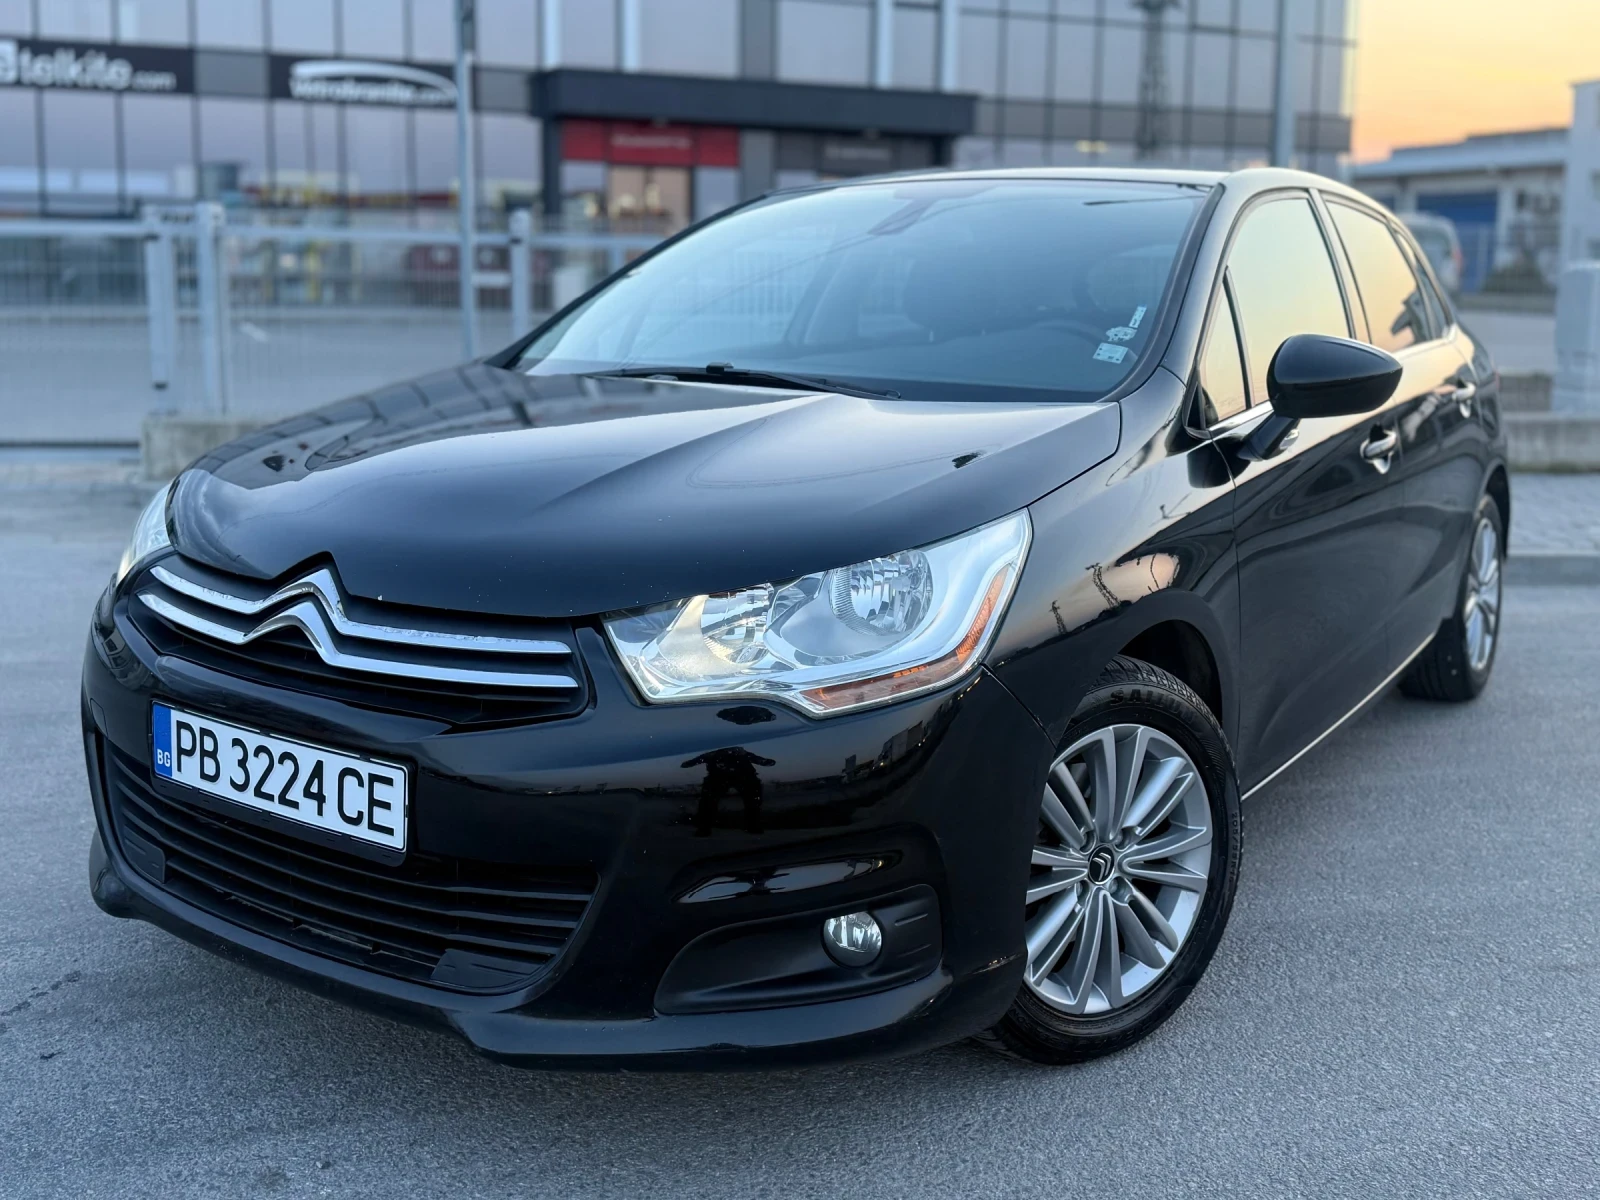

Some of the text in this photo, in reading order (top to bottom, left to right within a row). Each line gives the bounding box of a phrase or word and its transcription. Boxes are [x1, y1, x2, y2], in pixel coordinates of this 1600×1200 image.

[157, 749, 171, 768] BG
[176, 719, 395, 837] PB 3224 CE
